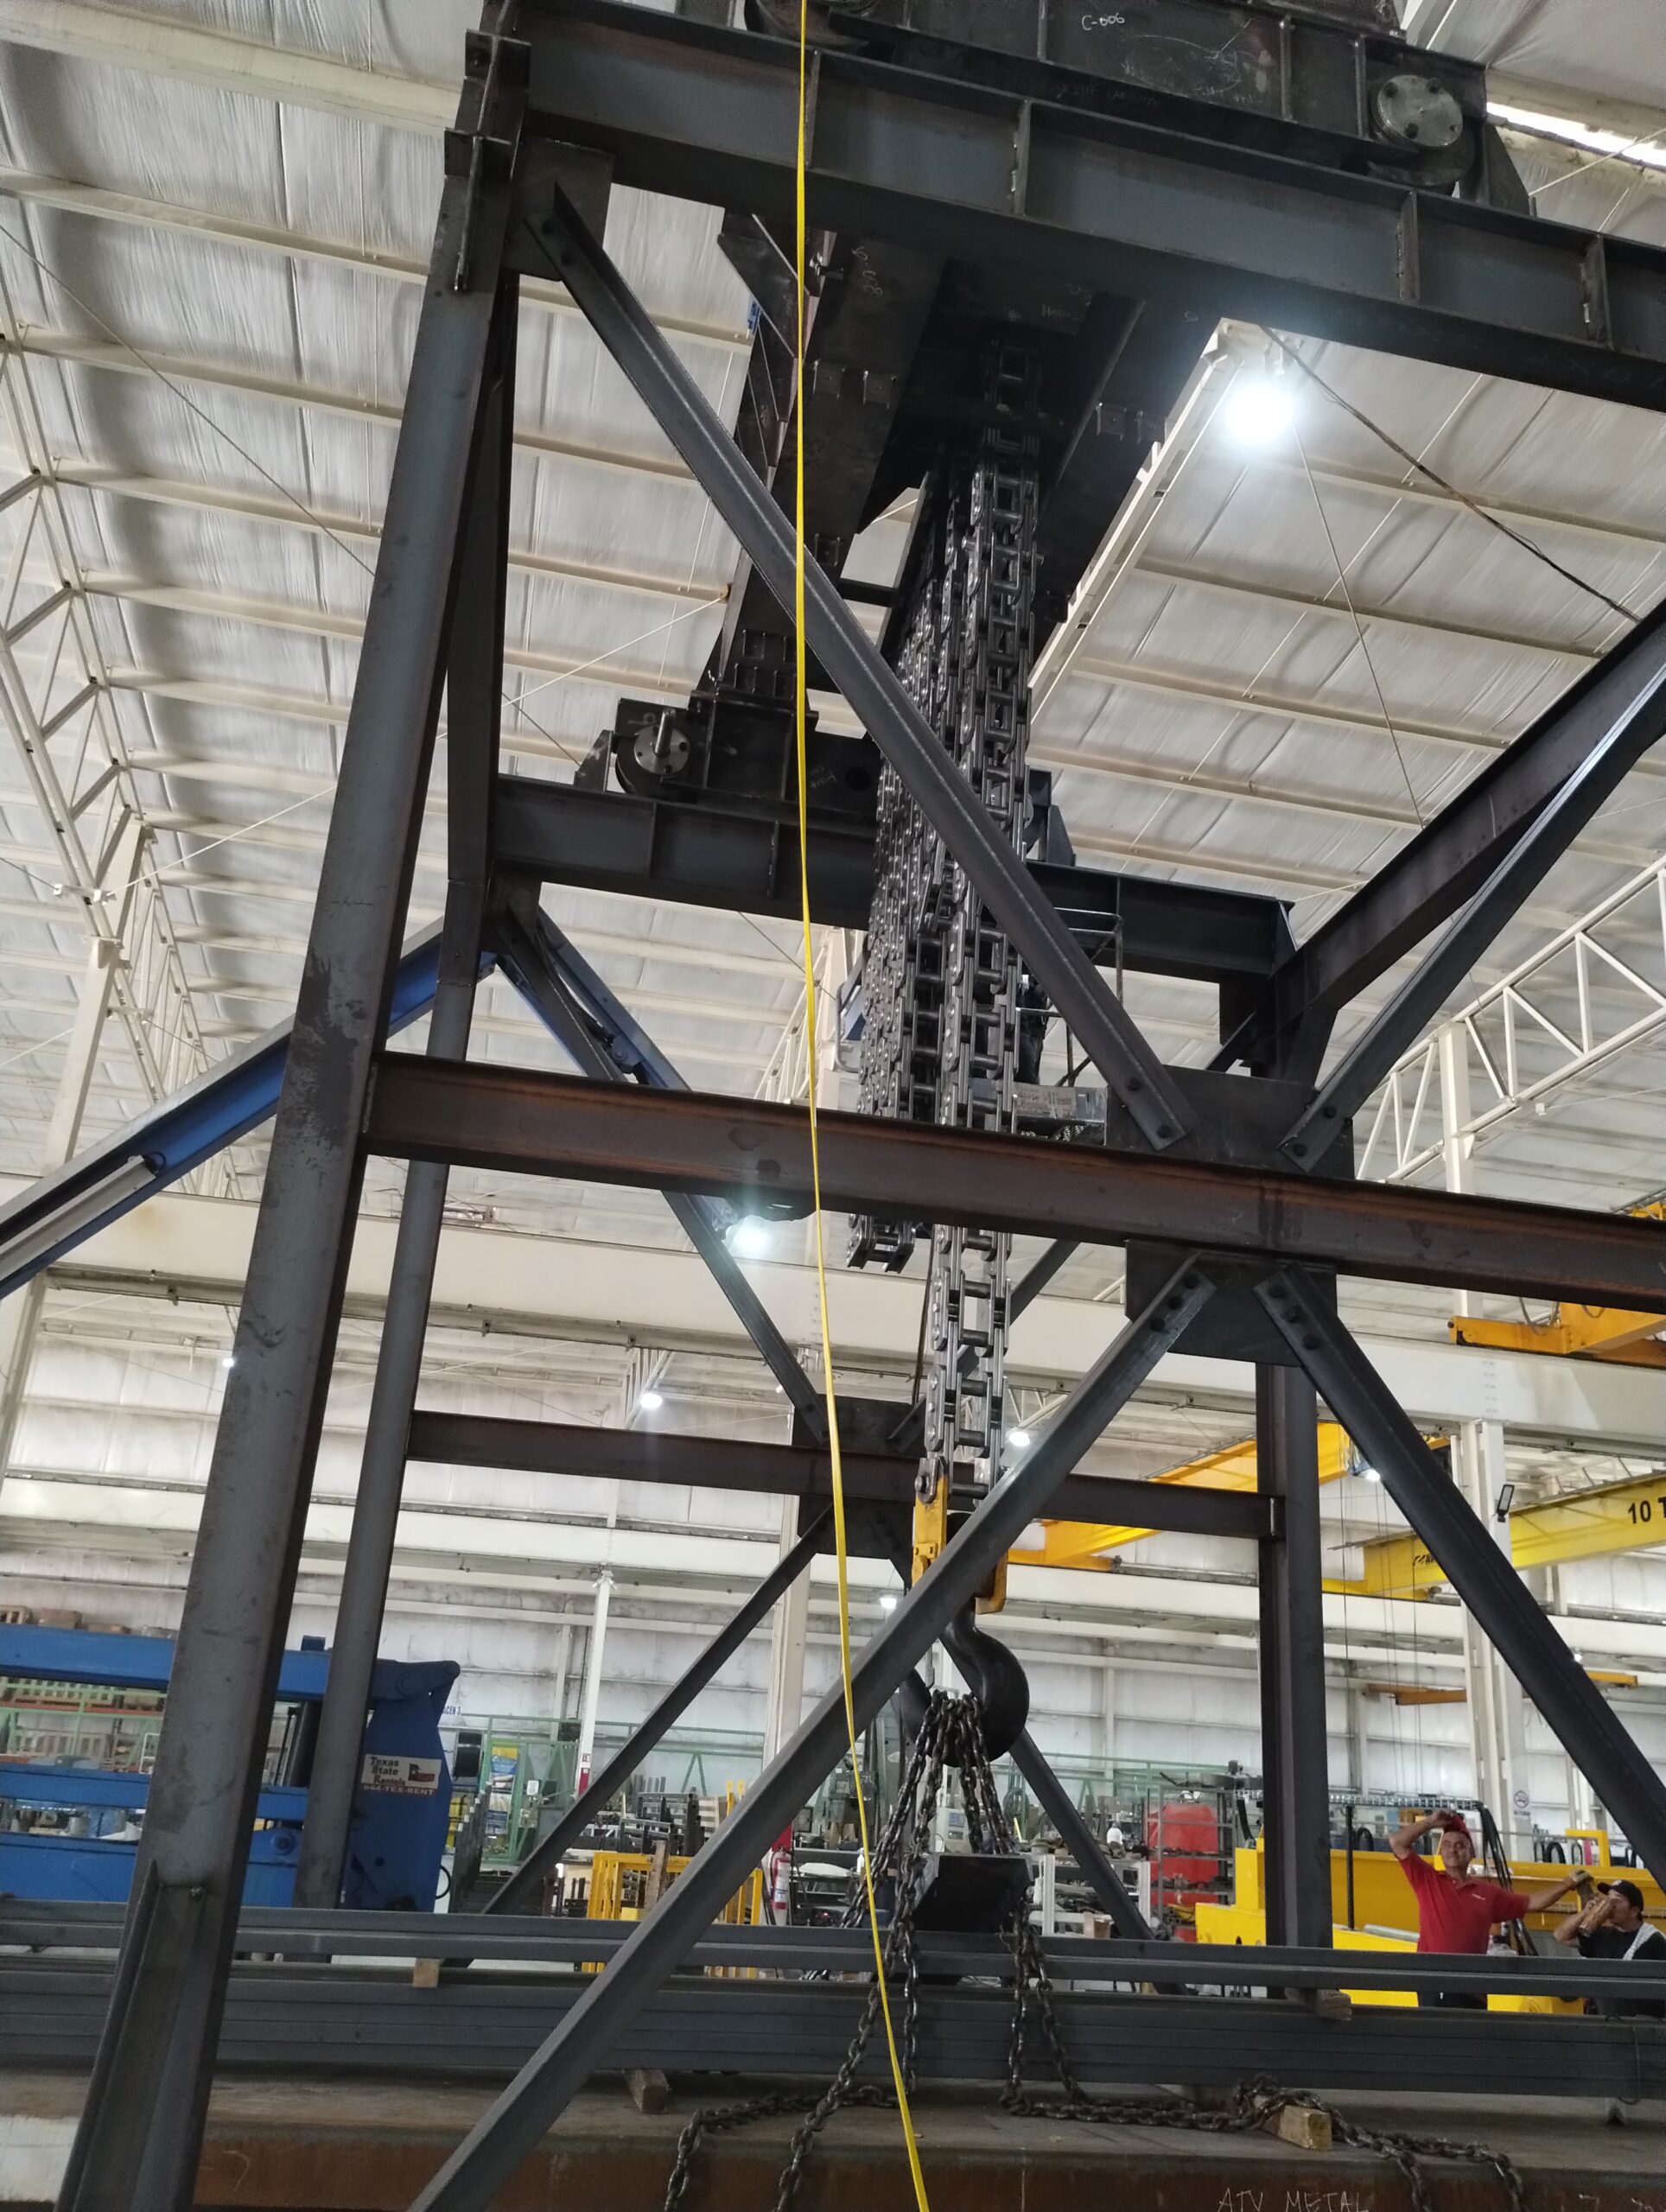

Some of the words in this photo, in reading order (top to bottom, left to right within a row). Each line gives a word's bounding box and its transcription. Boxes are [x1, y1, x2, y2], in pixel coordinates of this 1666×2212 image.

[1627, 1500, 1651, 1524] 10
[370, 1756, 399, 1767] Texas
[372, 1764, 398, 1776] State
[1286, 2190, 1369, 2212] METAL
